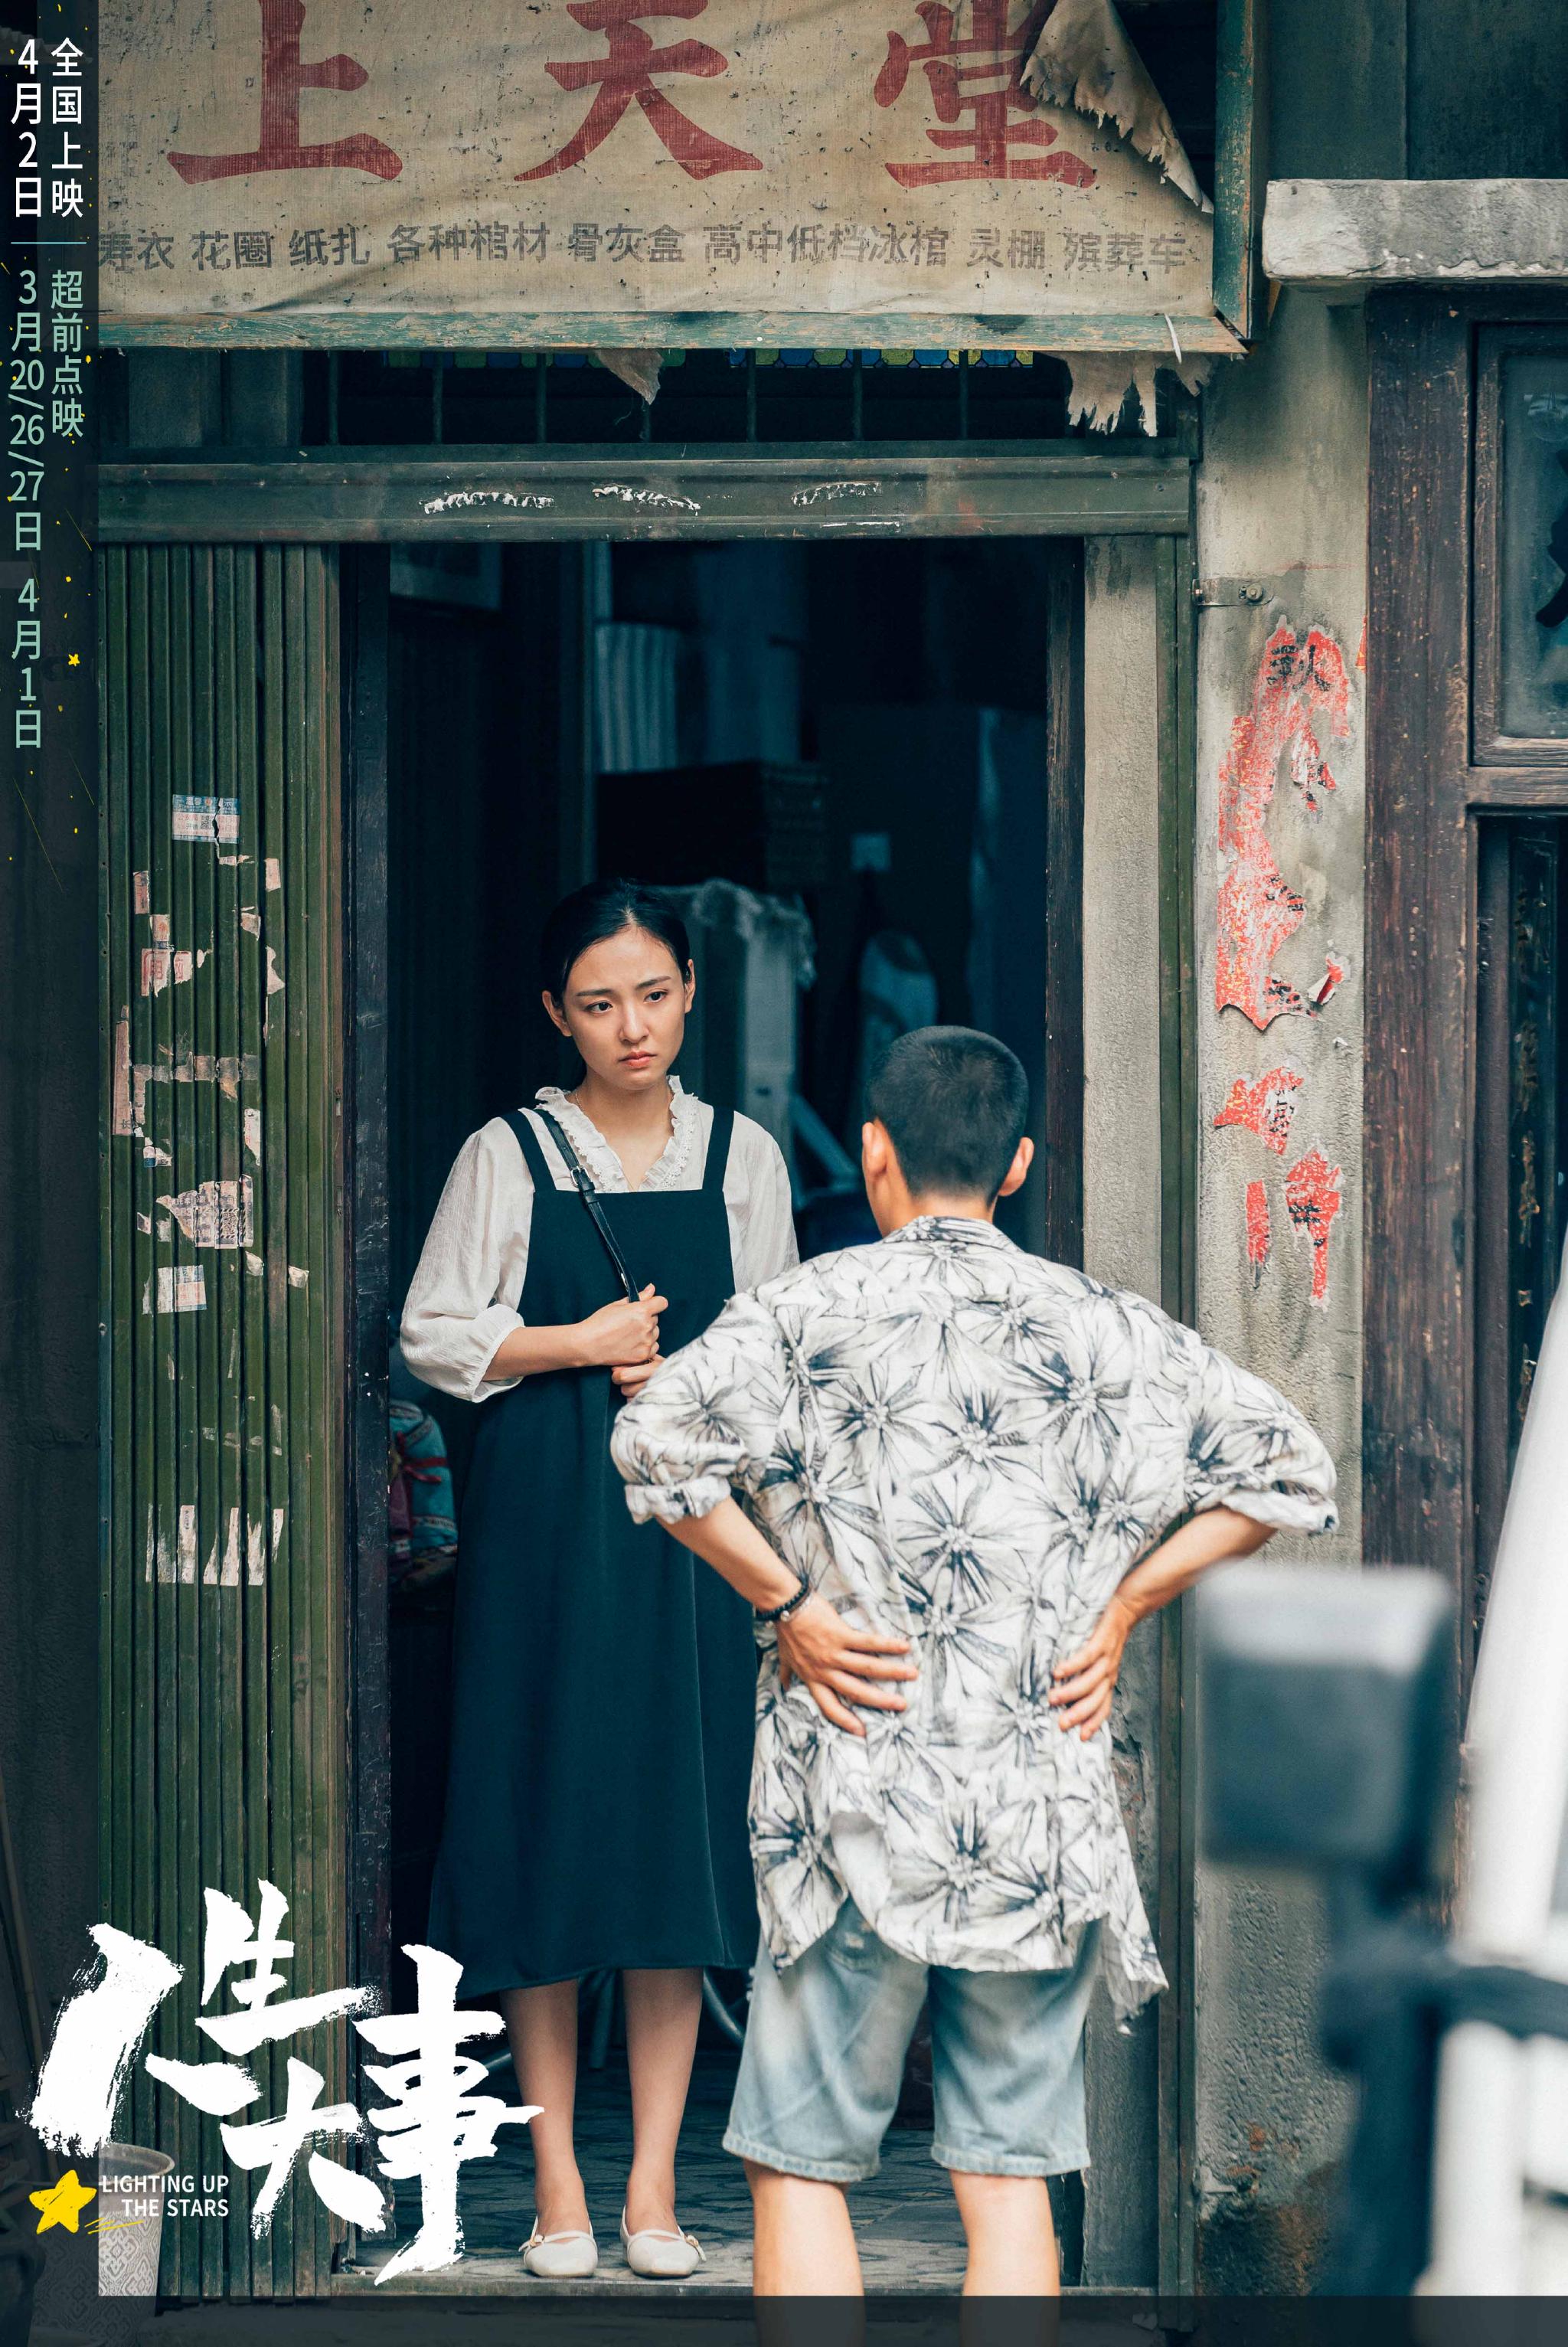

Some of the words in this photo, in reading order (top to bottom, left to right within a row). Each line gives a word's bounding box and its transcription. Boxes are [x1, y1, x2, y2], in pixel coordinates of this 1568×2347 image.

[166, 0, 1098, 189] 上天堂
[191, 230, 272, 270] 花圈
[289, 227, 371, 266] 纸扎
[387, 221, 550, 263] 各种棺材
[568, 222, 686, 263] 骨灰盒
[703, 222, 950, 266] 高中低档冰棺
[966, 228, 1047, 270] 灵棚
[1058, 231, 1187, 274] 殡葬车
